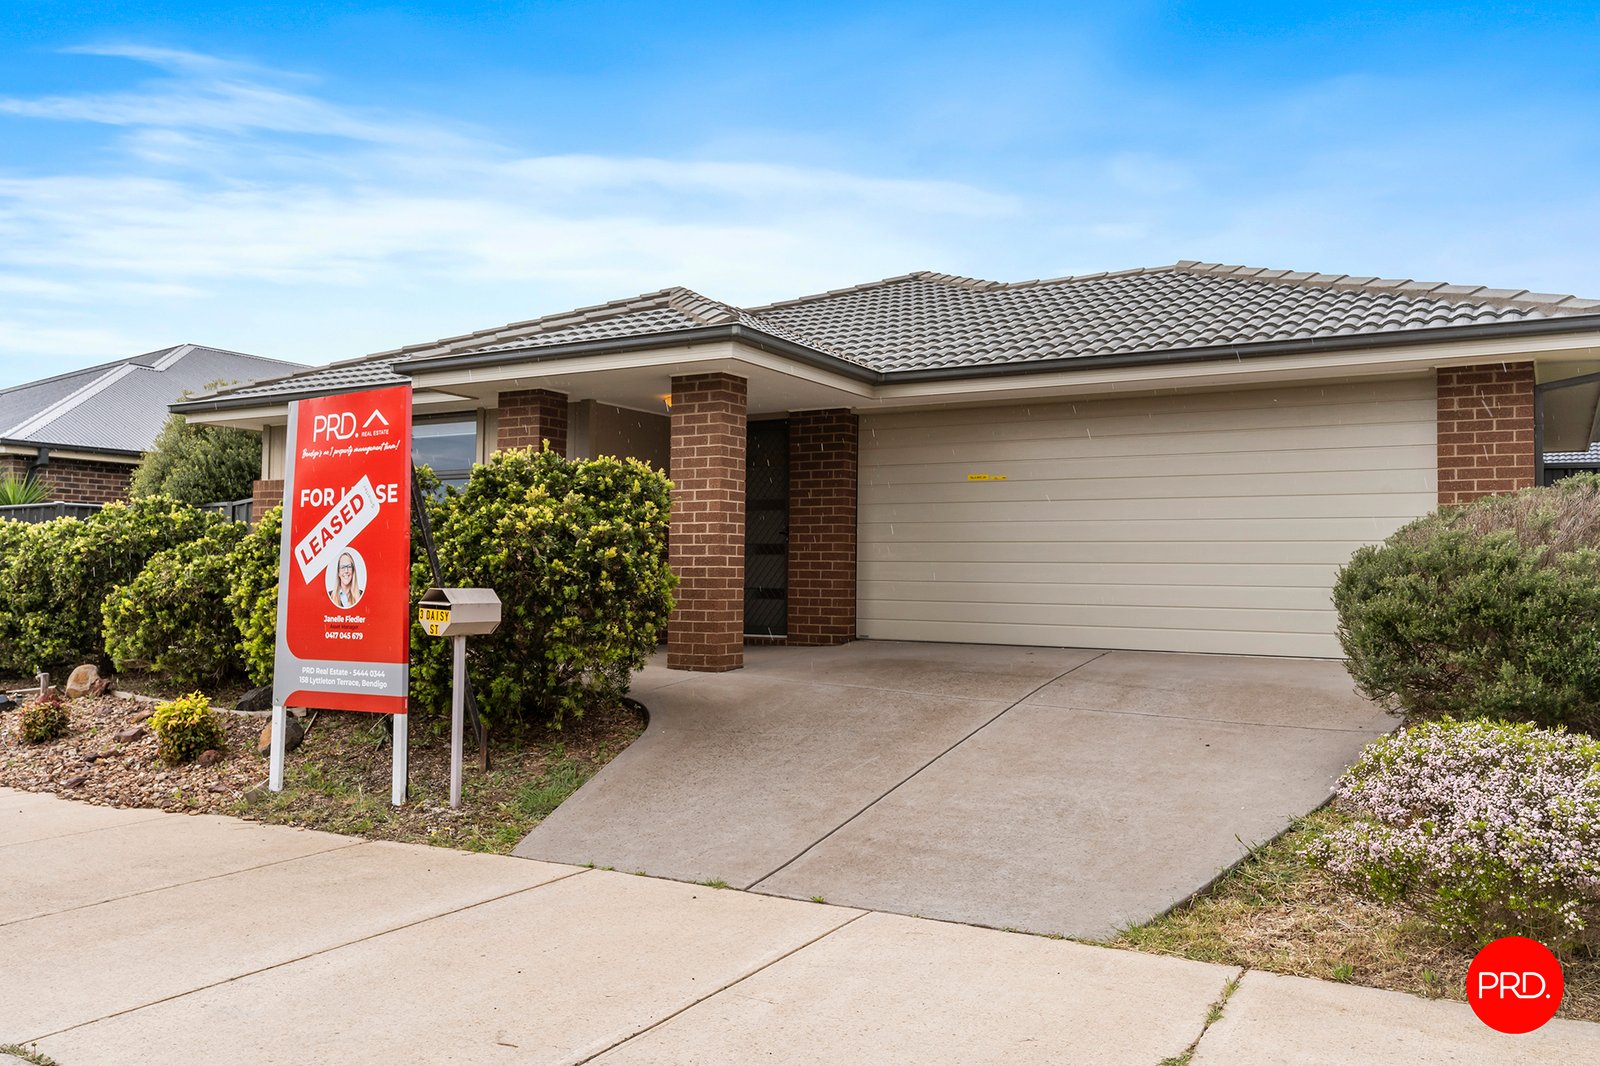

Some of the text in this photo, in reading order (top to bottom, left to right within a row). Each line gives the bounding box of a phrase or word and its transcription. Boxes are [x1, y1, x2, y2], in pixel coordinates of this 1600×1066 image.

[300, 487, 335, 507] FOR
[300, 493, 364, 566] LEASED
[323, 615, 366, 623] Janelle Fiedler
[425, 610, 450, 622] DAISY
[430, 624, 439, 635] ST
[351, 632, 364, 640] 679
[302, 666, 315, 674] PRD
[315, 667, 329, 675] Real
[329, 668, 349, 676] Estate
[352, 669, 369, 677] 5444
[369, 670, 386, 678] 0344
[299, 676, 388, 689] 158 Lyttleton Terrace, Bendigo
